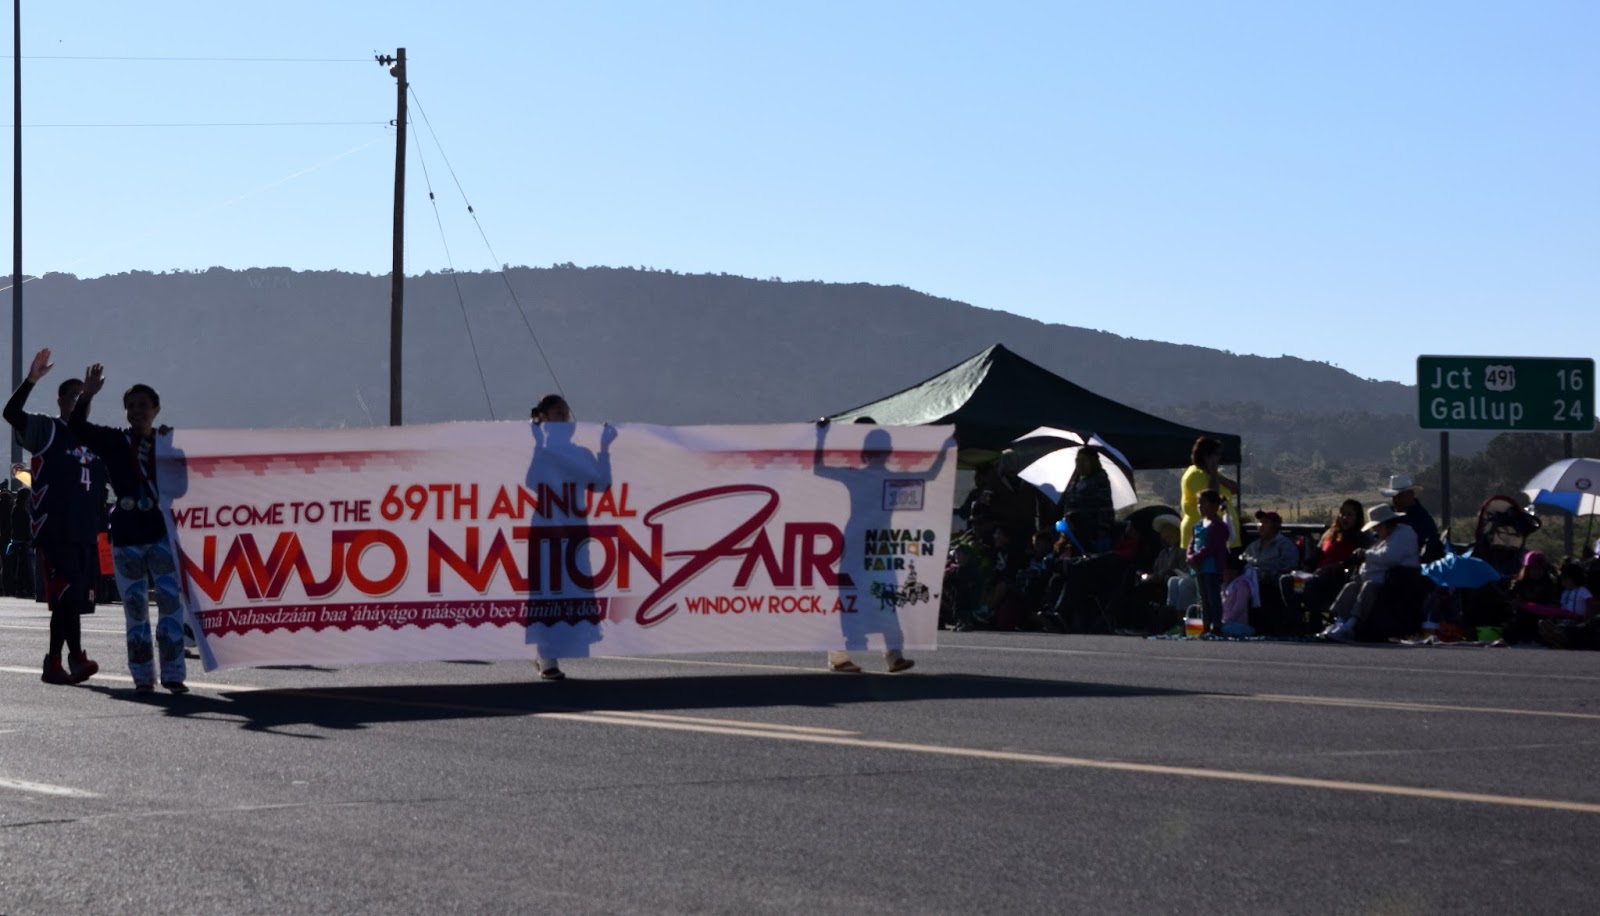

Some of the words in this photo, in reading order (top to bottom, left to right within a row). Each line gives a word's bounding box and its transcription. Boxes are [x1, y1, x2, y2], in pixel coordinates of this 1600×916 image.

[1431, 367, 1472, 389] Jct
[1487, 370, 1514, 387] 491
[1557, 369, 1583, 391] 16
[1431, 397, 1523, 426] Gallup
[1553, 400, 1583, 421] 24
[80, 466, 92, 492] 4
[171, 503, 284, 529] WELCOME
[290, 502, 324, 524] TO
[330, 500, 371, 522] THE
[380, 483, 479, 521] 69TH
[488, 482, 637, 519] ANNUAL
[864, 529, 936, 543] NAVAJO
[175, 529, 408, 603] NAVAJO
[428, 524, 663, 593] NATION
[636, 484, 855, 625] FAIR
[864, 557, 905, 571] FAIR
[489, 602, 516, 618] bee
[685, 595, 764, 615] WINDOW
[769, 595, 826, 615] ROCK,
[832, 595, 858, 613] AZ
